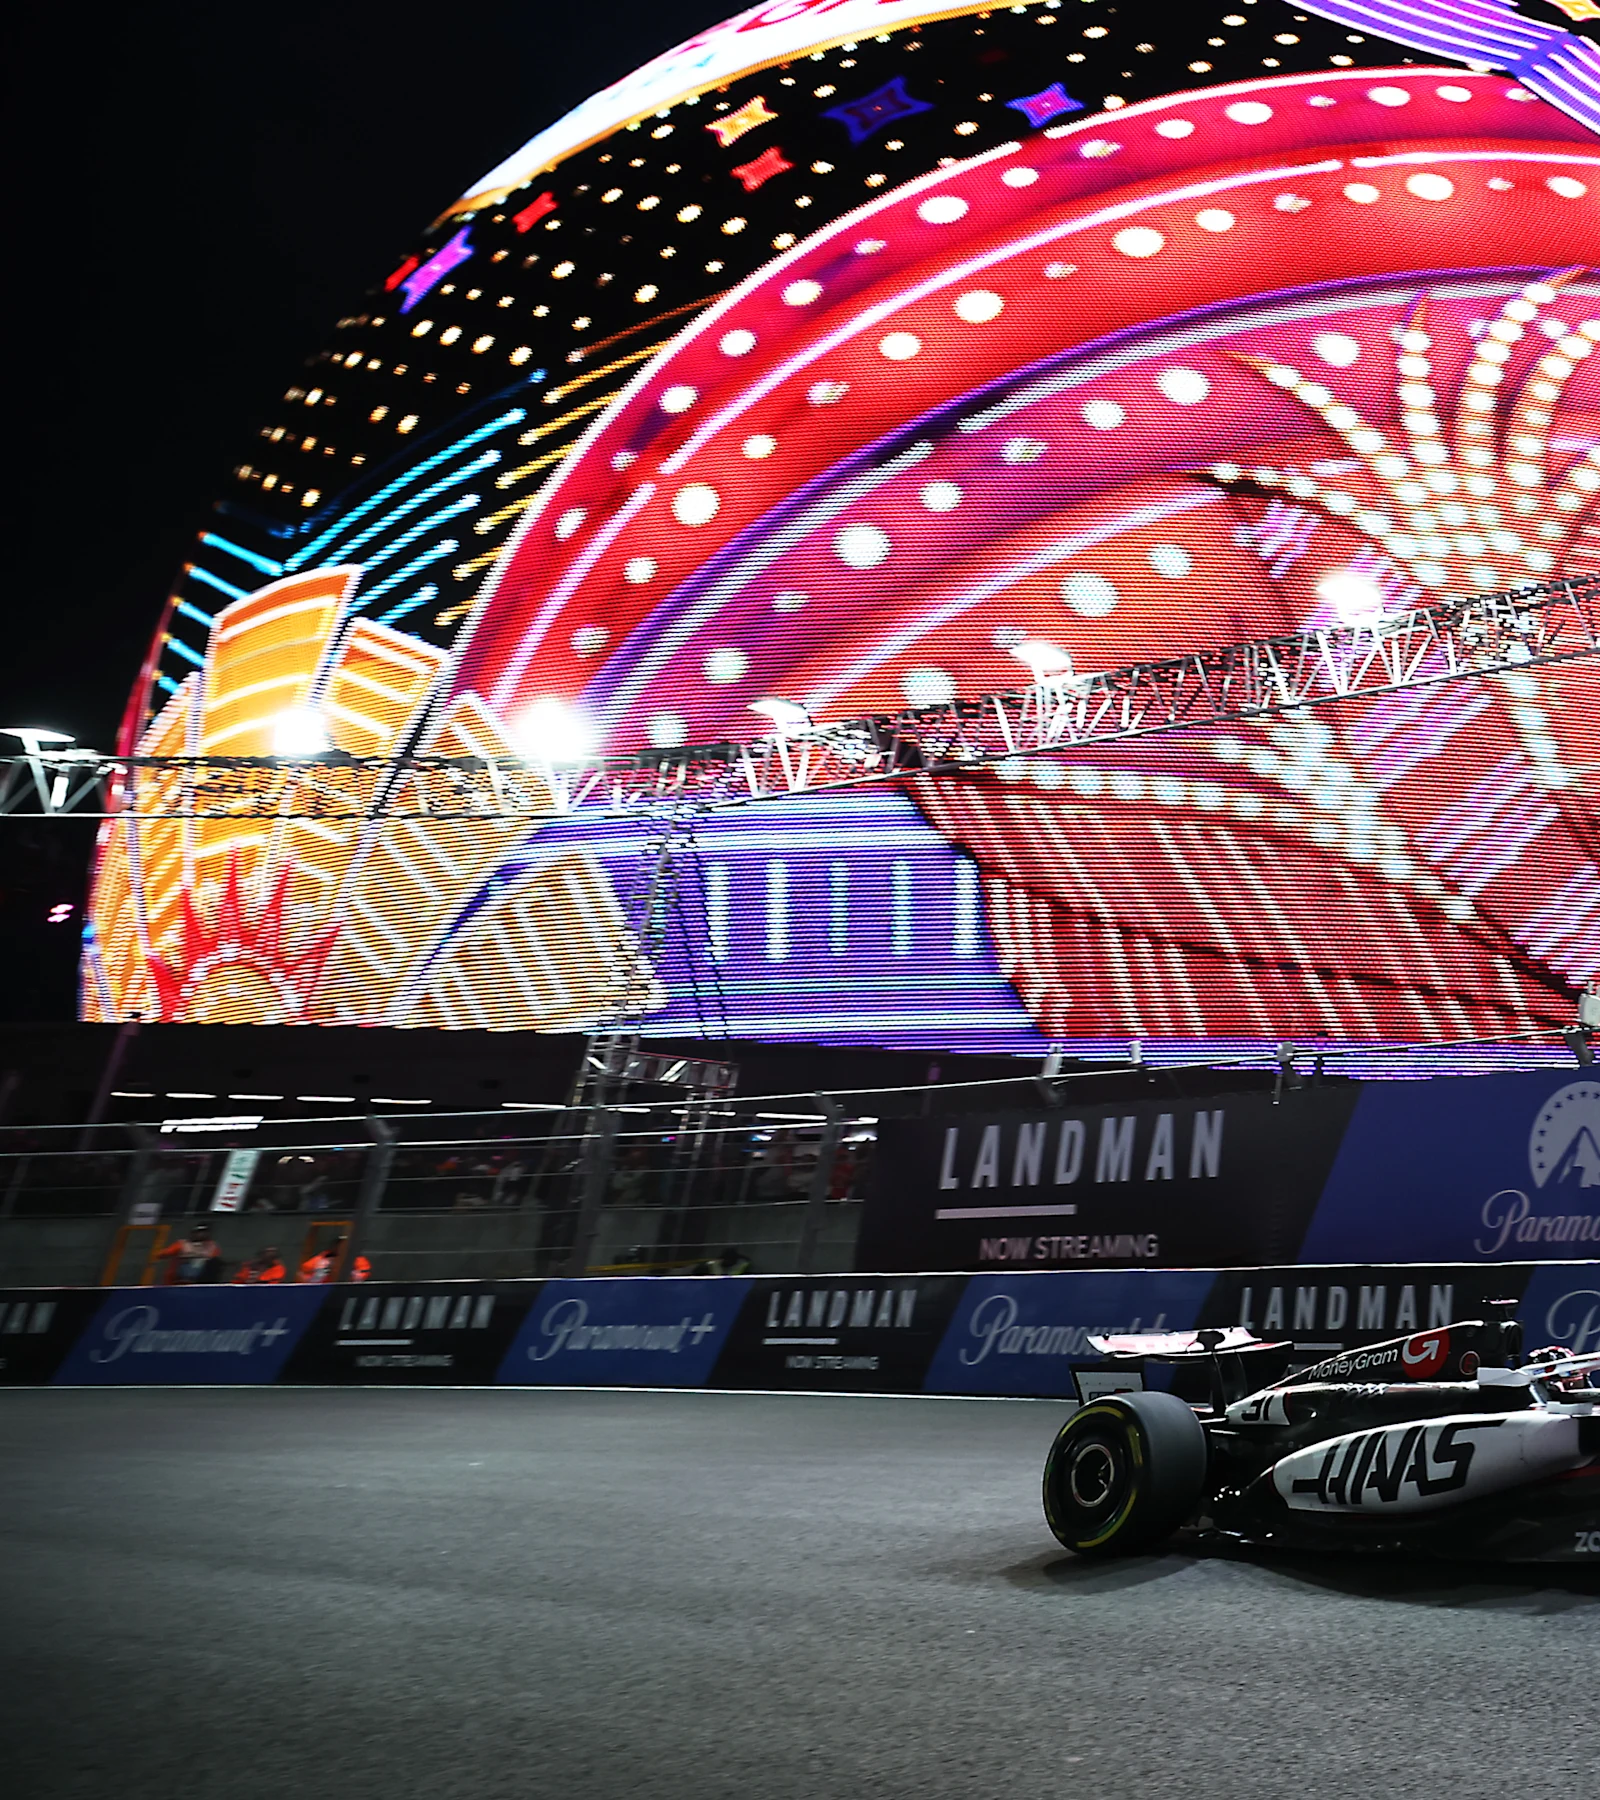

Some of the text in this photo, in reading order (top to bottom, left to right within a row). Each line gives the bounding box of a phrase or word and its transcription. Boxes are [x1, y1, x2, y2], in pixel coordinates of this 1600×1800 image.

[939, 1108, 1225, 1191] LANDMAN
[979, 1233, 1159, 1261] NOW STREAMING
[764, 1289, 918, 1329] LANDMAN
[1239, 1284, 1454, 1331] LANDMAN
[1307, 1347, 1399, 1381] MoneyGram
